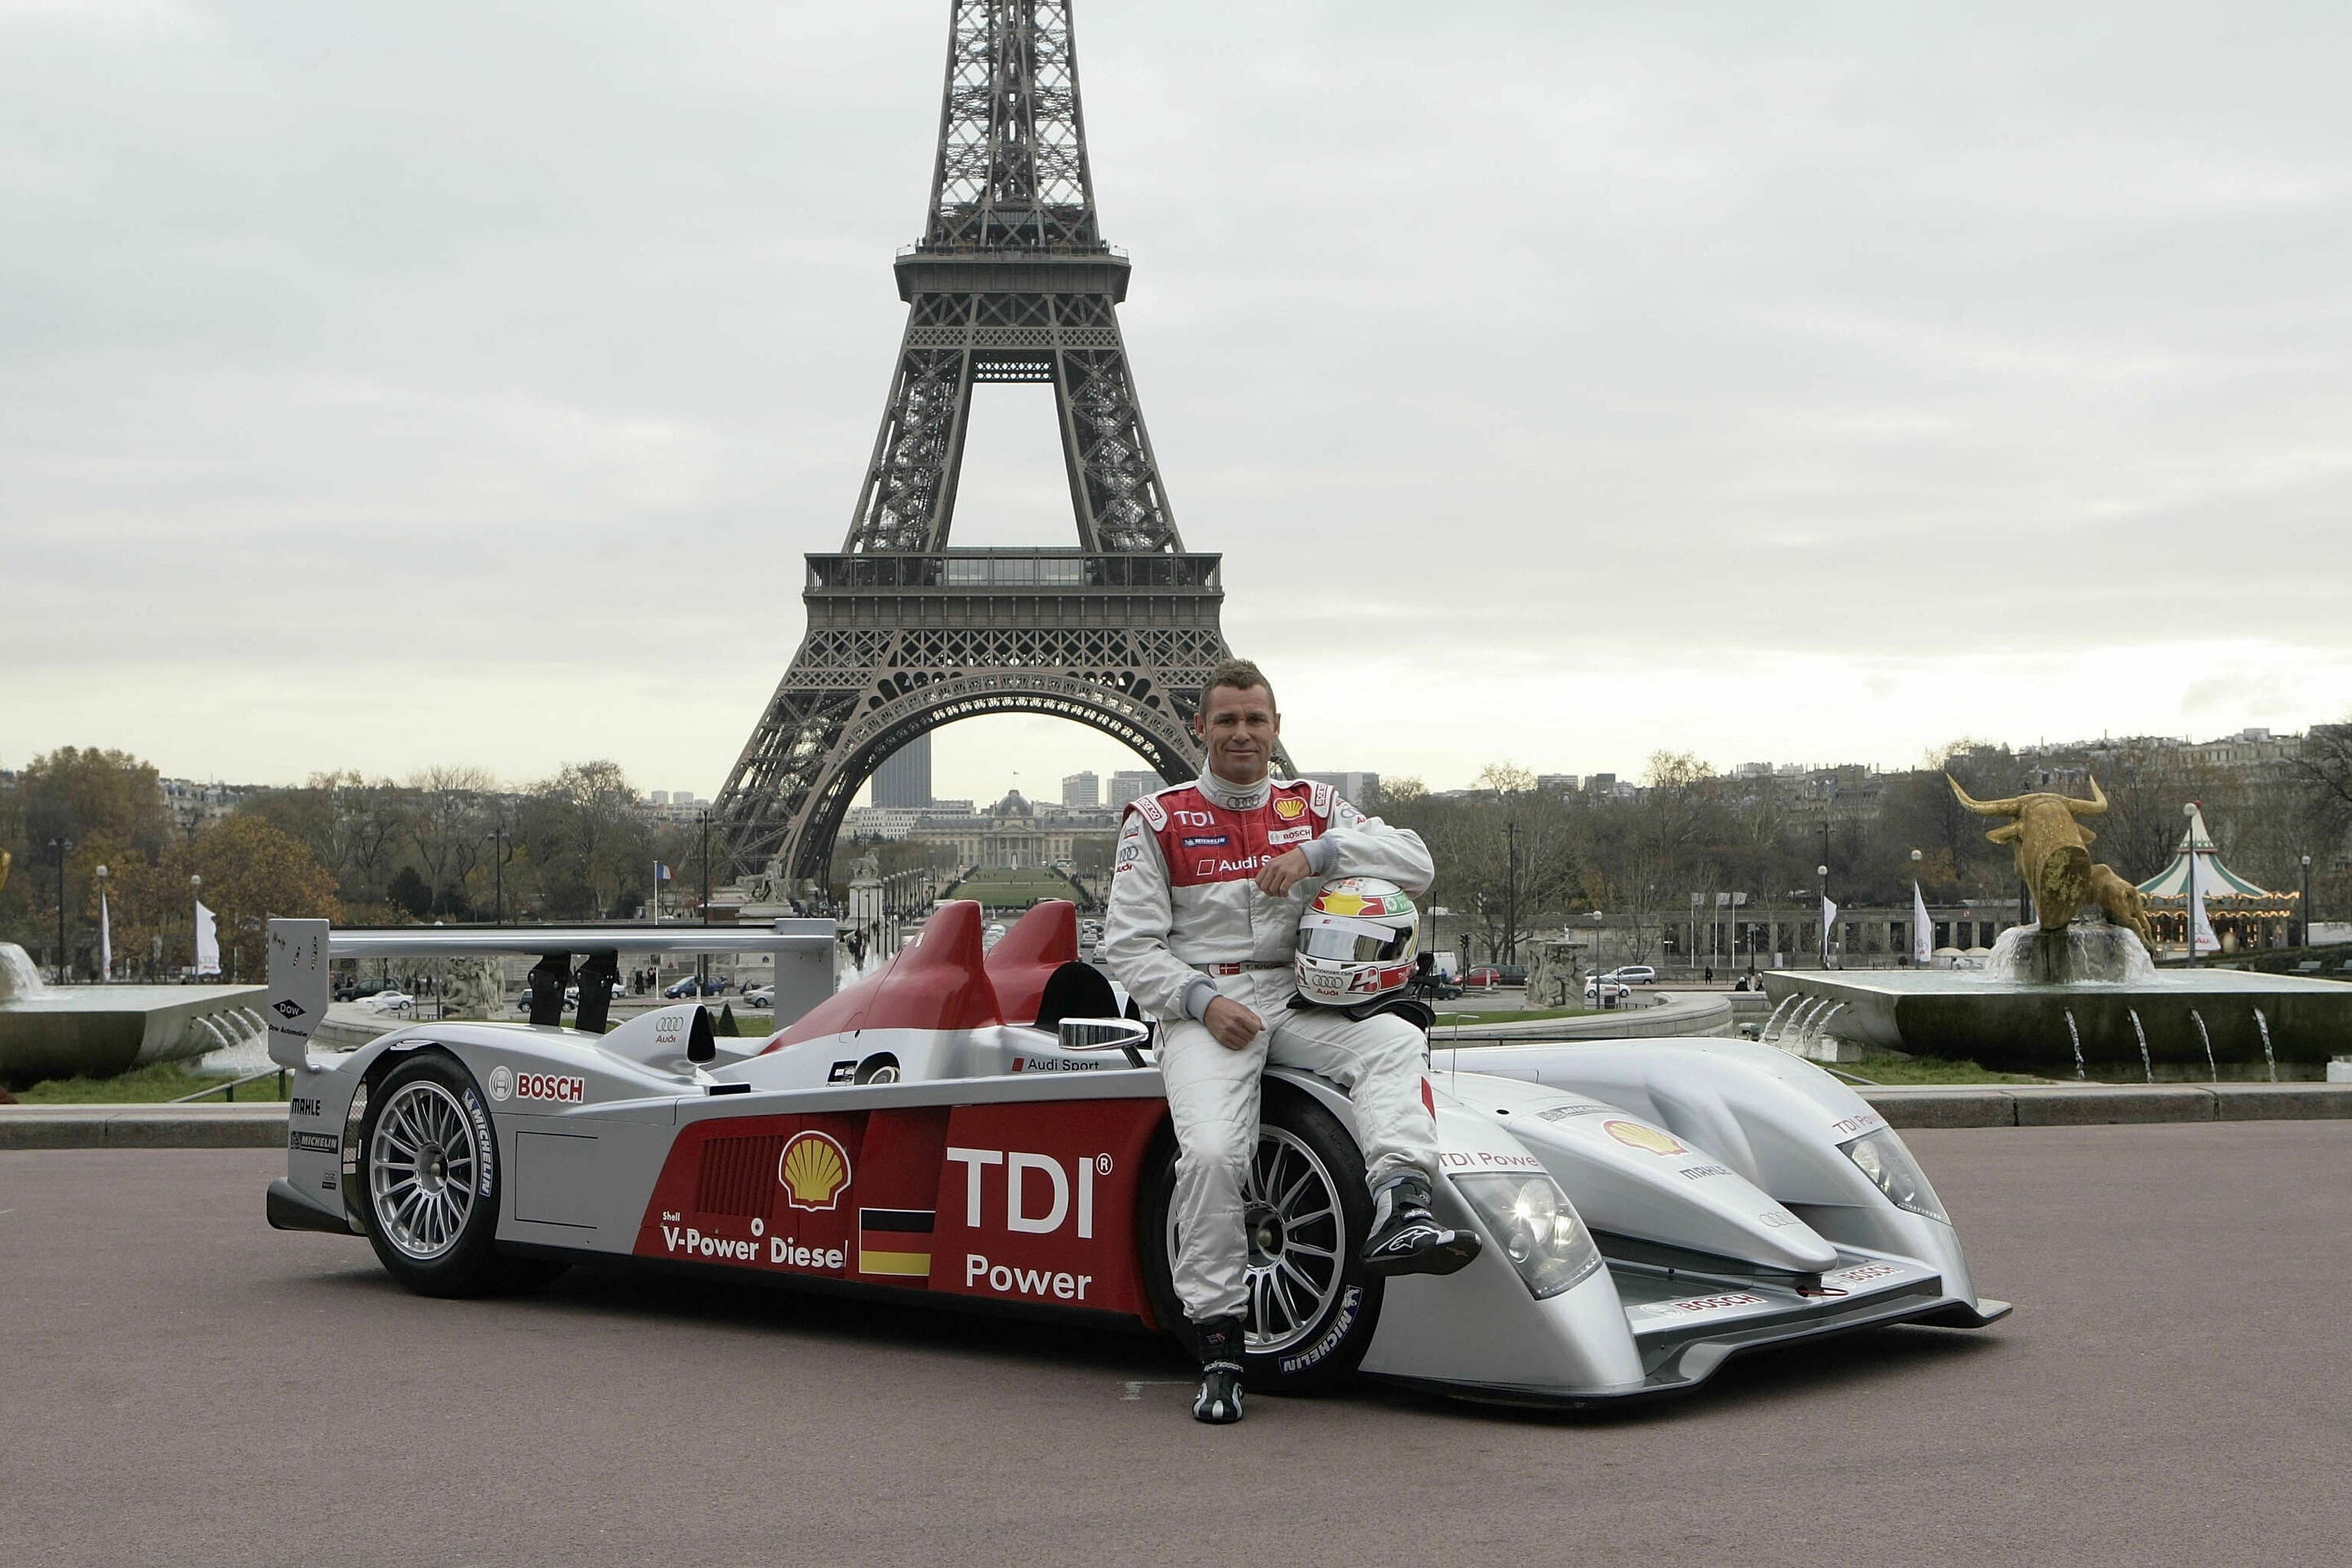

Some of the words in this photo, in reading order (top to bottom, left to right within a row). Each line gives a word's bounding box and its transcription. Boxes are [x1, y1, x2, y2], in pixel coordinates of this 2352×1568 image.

[1174, 811, 1215, 826] TDI
[1283, 829, 1311, 840] BOSCH
[1218, 856, 1258, 871] Audi
[656, 1035, 676, 1043] Audi
[1027, 1059, 1058, 1071] Audi
[1062, 1059, 1099, 1071] Sport
[518, 1075, 583, 1101] BOSCH
[292, 1098, 320, 1116] MAHLE
[1832, 1118, 1861, 1134] TDI
[301, 1136, 337, 1149] MICHELIN
[472, 1109, 492, 1195] MICHELIN
[1439, 1153, 1476, 1167] TDI
[1477, 1152, 1539, 1167] Powe
[662, 1212, 680, 1222] Shell
[663, 1226, 760, 1261] V-Power
[771, 1236, 849, 1268] Diesel
[966, 1254, 1092, 1300] Power
[1839, 1265, 1901, 1281] BOSCH
[1675, 1294, 1762, 1311] BOSCH
[1283, 1310, 1352, 1372] MICHELIN
